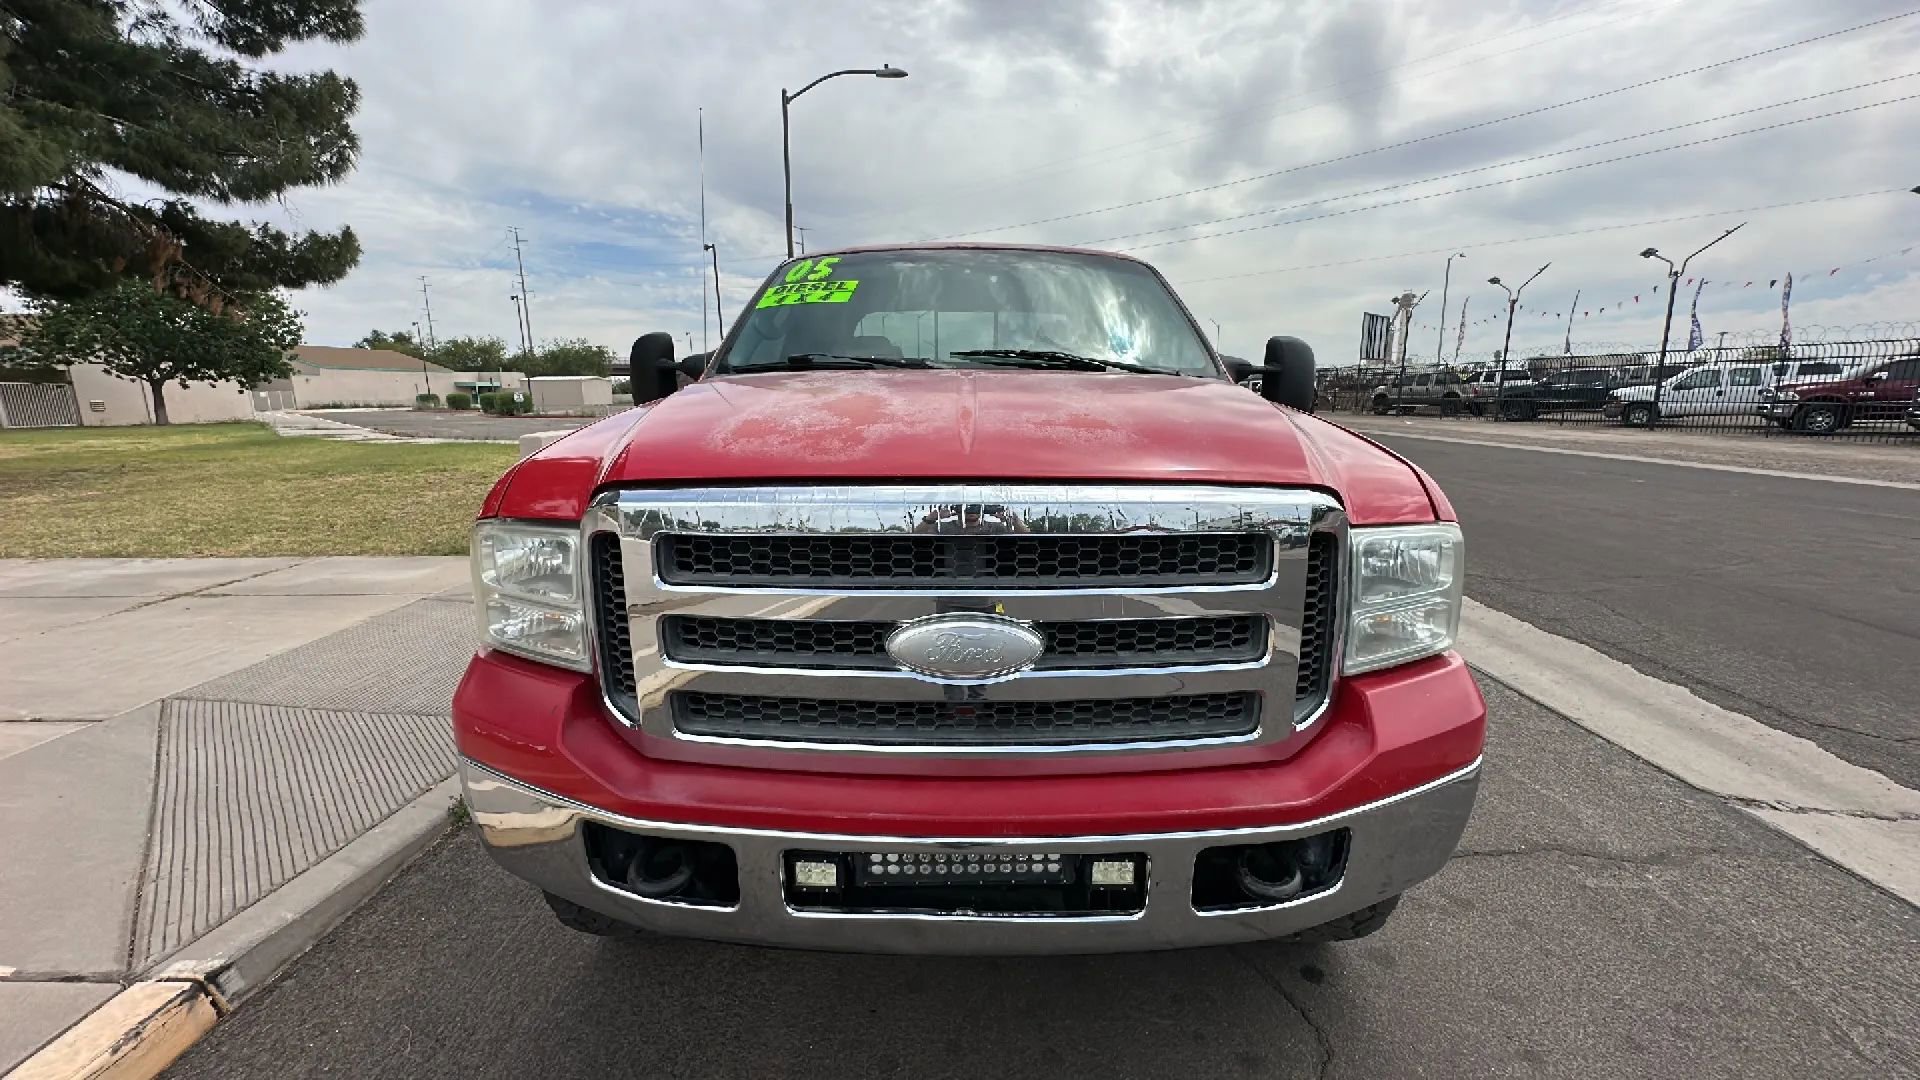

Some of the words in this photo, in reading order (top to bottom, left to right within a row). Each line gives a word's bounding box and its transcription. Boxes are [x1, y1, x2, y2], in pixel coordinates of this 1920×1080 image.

[785, 257, 841, 282] 05
[772, 281, 849, 295] DIESEL
[923, 631, 1007, 664] Ford
